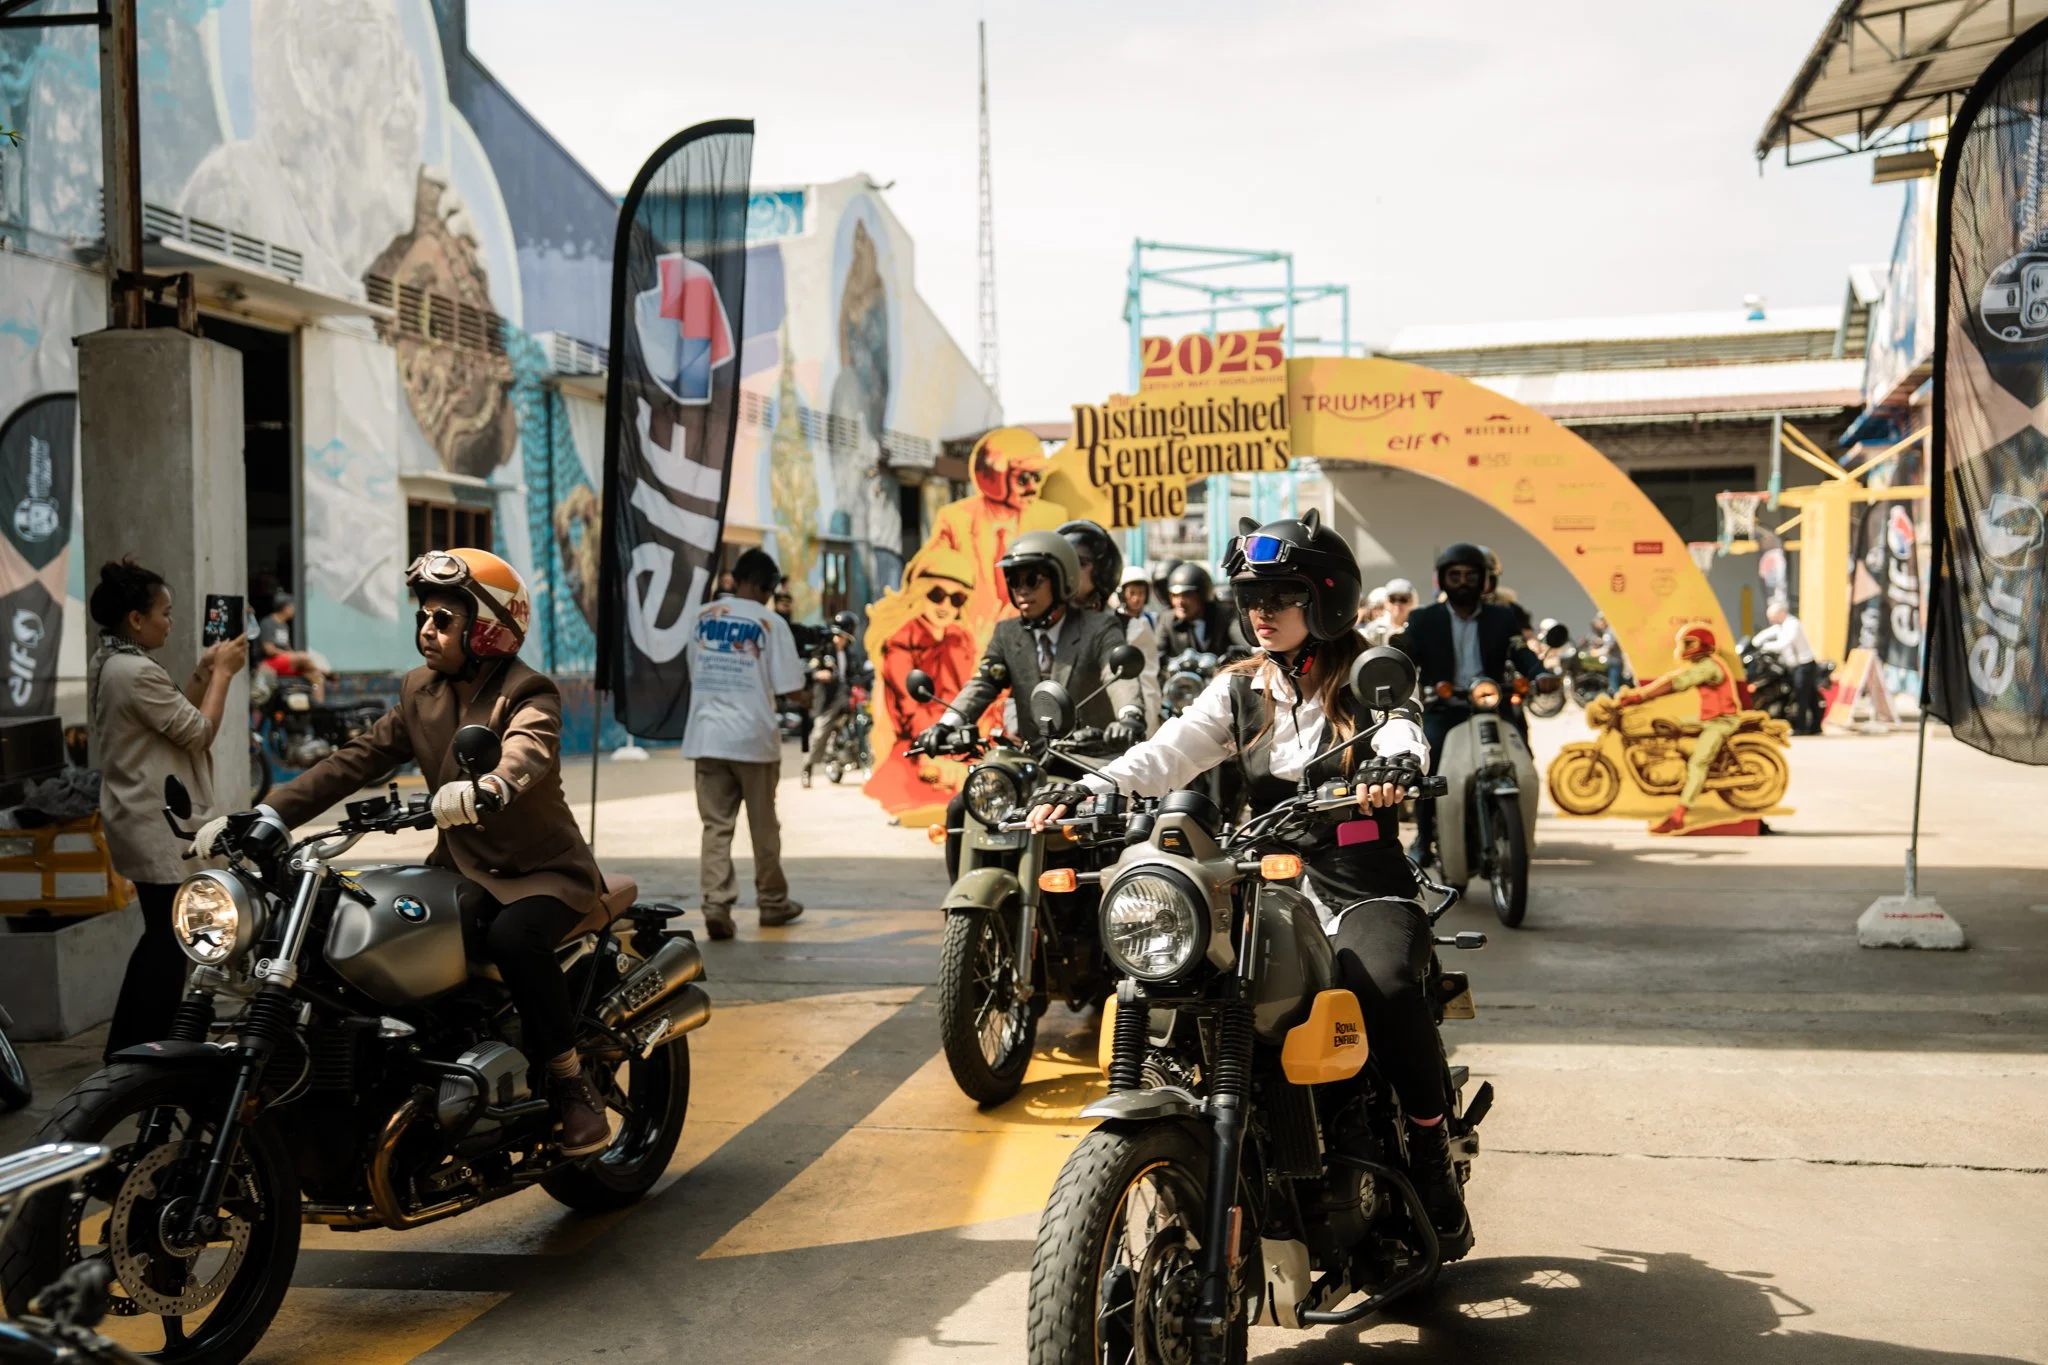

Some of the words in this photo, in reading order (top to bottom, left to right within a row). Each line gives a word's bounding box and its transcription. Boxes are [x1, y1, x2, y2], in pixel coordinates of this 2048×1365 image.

[1142, 327, 1285, 377] 2025
[1074, 394, 1286, 450] Distinguished
[1301, 392, 1415, 412] TRIUMPH
[1088, 436, 1289, 488] Gentleman's
[1387, 434, 1425, 450] elf
[1110, 481, 1184, 527] Ride
[626, 397, 722, 664] elf
[1888, 558, 1921, 648] elf
[9, 641, 37, 707] elf
[1334, 1034, 1360, 1047] ENFIELD
[1335, 1022, 1357, 1034] ROYAL
